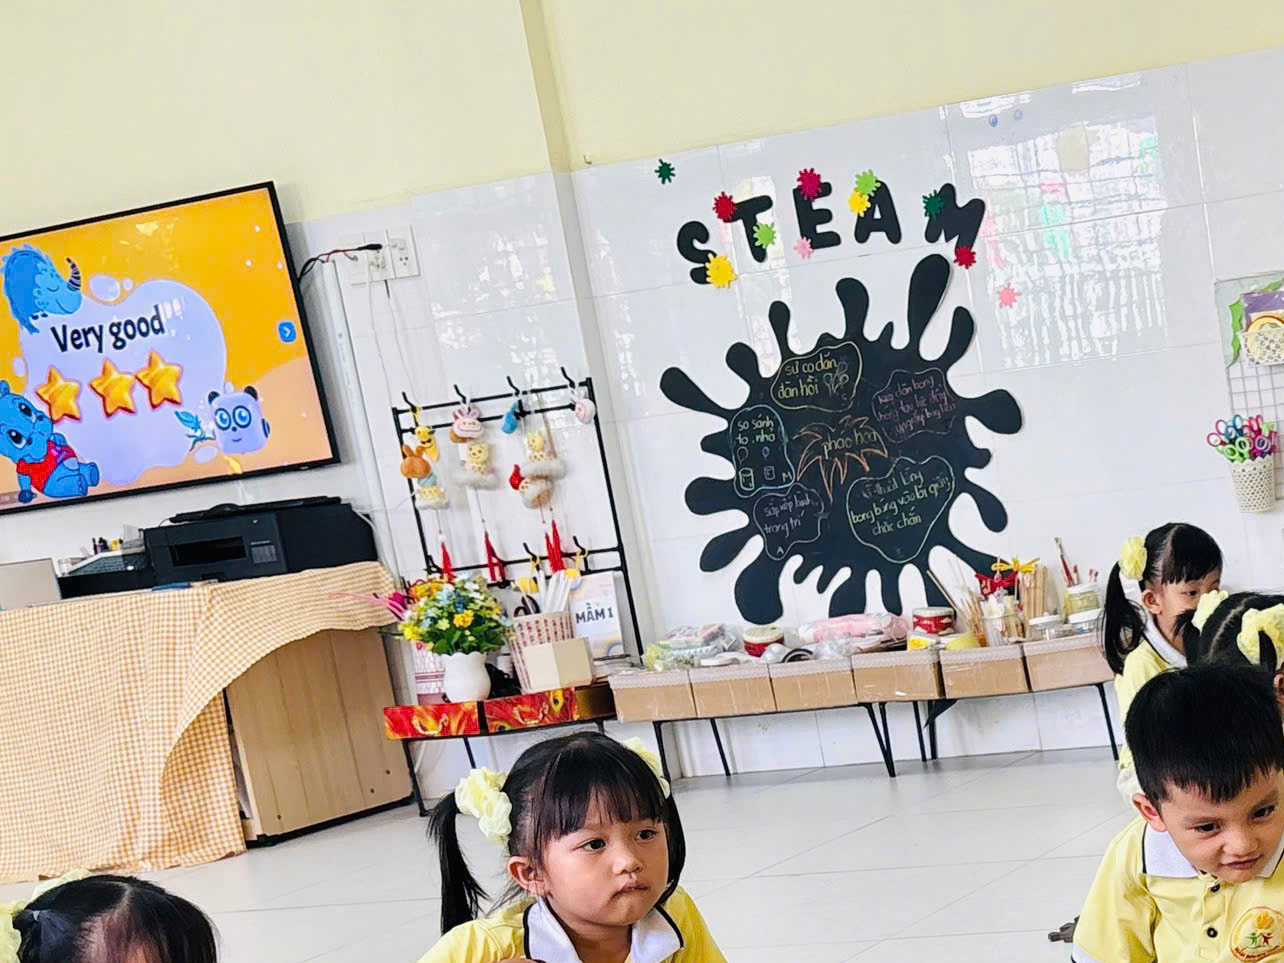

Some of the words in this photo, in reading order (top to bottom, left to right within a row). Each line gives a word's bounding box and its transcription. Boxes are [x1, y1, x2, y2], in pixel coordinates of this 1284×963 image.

[676, 176, 986, 285] STEAM
[50, 323, 104, 353] Very
[108, 303, 166, 350] good
[738, 421, 749, 431] so
[752, 413, 774, 429] sánh
[736, 433, 748, 444] to
[782, 471, 793, 482] M
[776, 546, 785, 555] A
[575, 602, 606, 625] MẦM
[607, 606, 614, 619] 1
